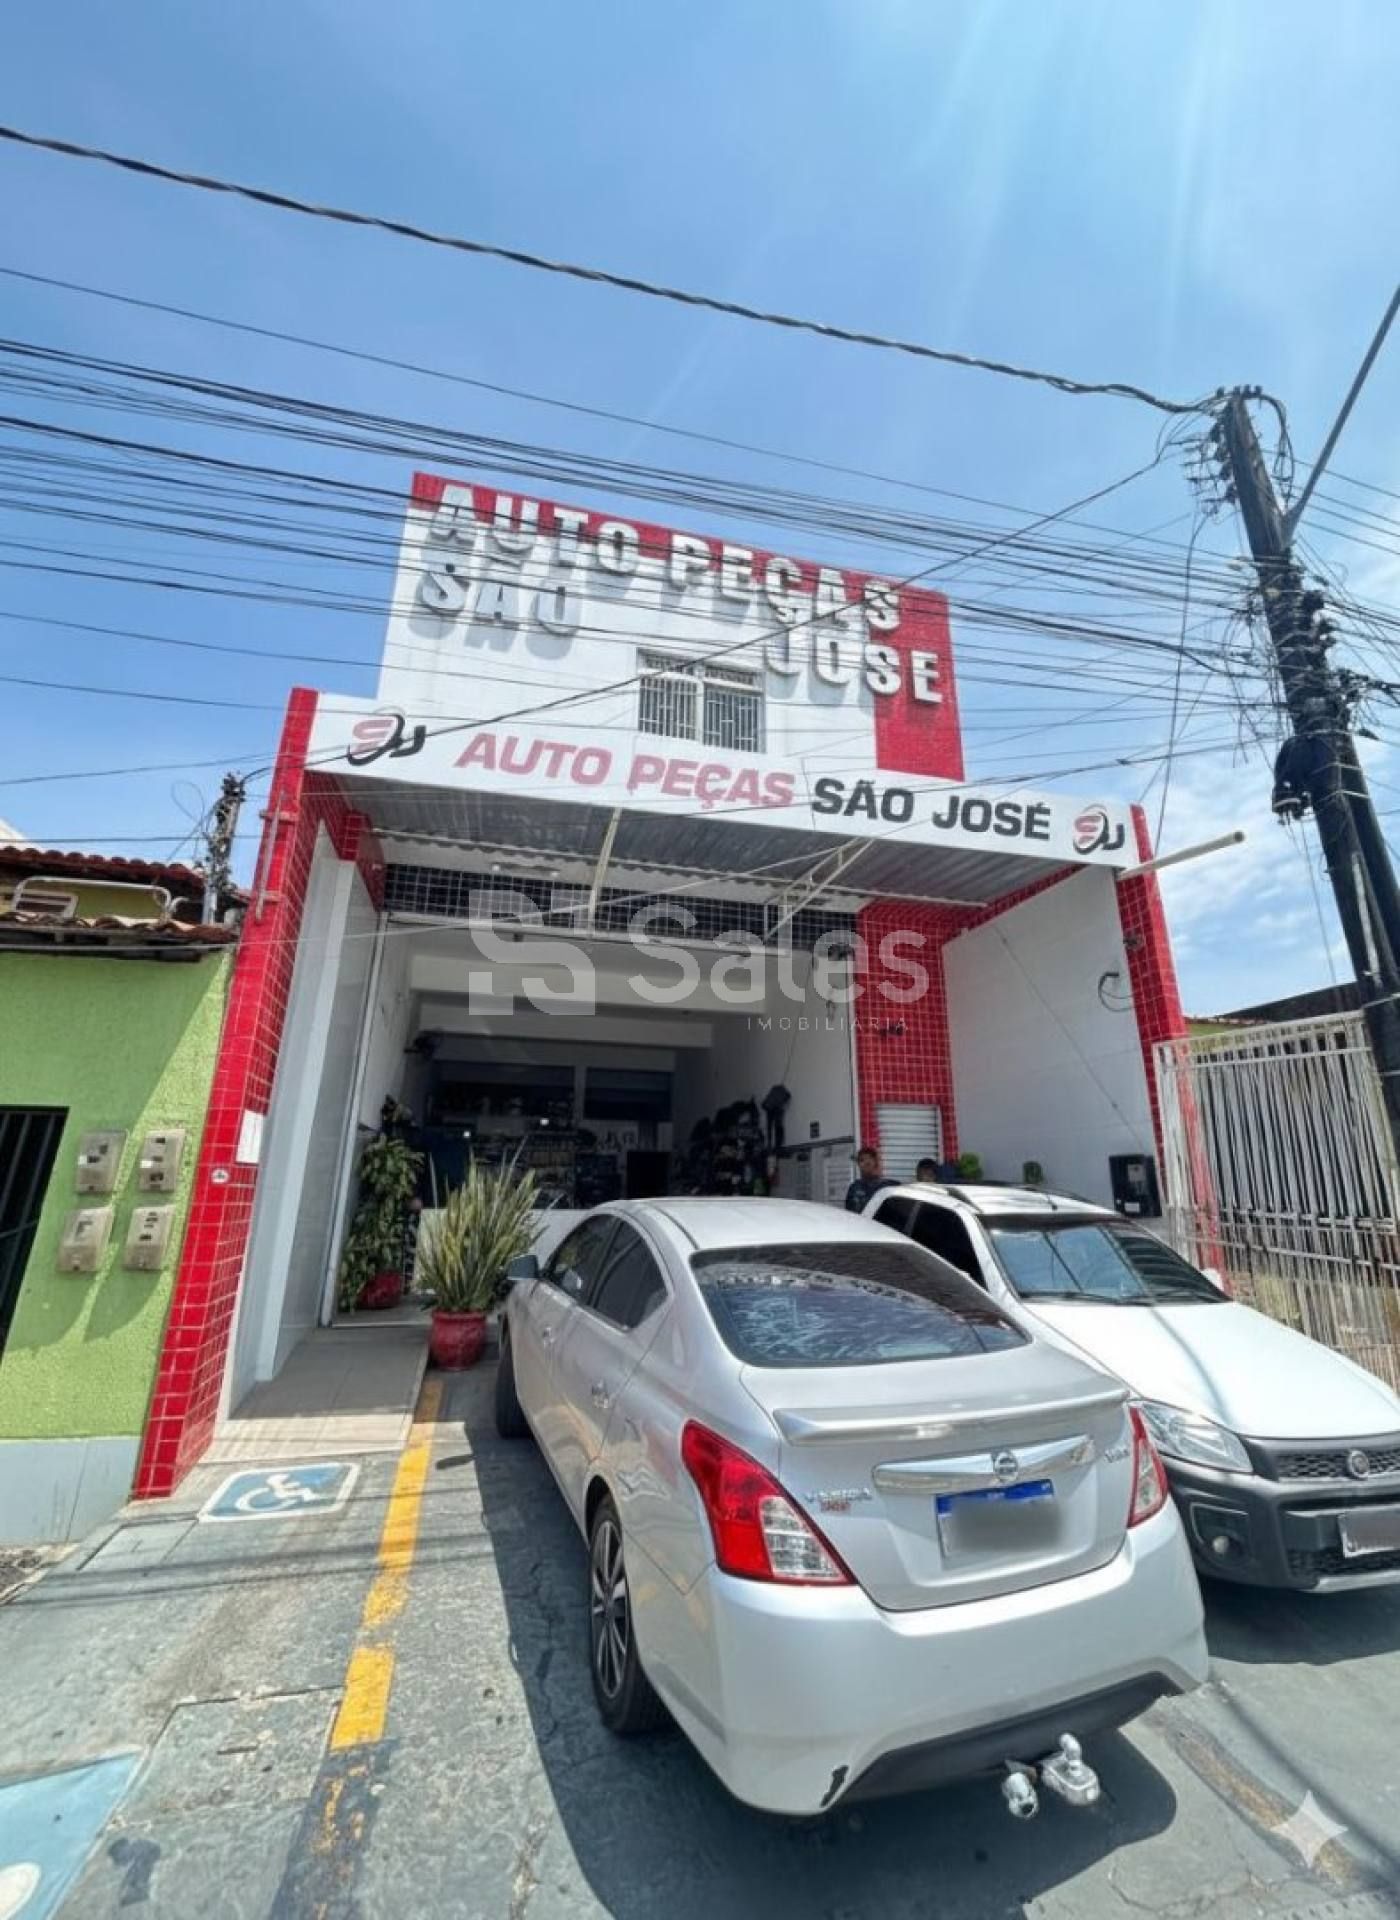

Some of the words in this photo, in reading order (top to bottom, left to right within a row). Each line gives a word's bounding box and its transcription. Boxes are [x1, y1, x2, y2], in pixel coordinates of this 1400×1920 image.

[430, 484, 640, 574] AUTO
[453, 731, 612, 786] AUTO
[626, 754, 796, 810] PEÇAS
[811, 777, 915, 824] SÃO
[931, 801, 1052, 841] JOSÉ
